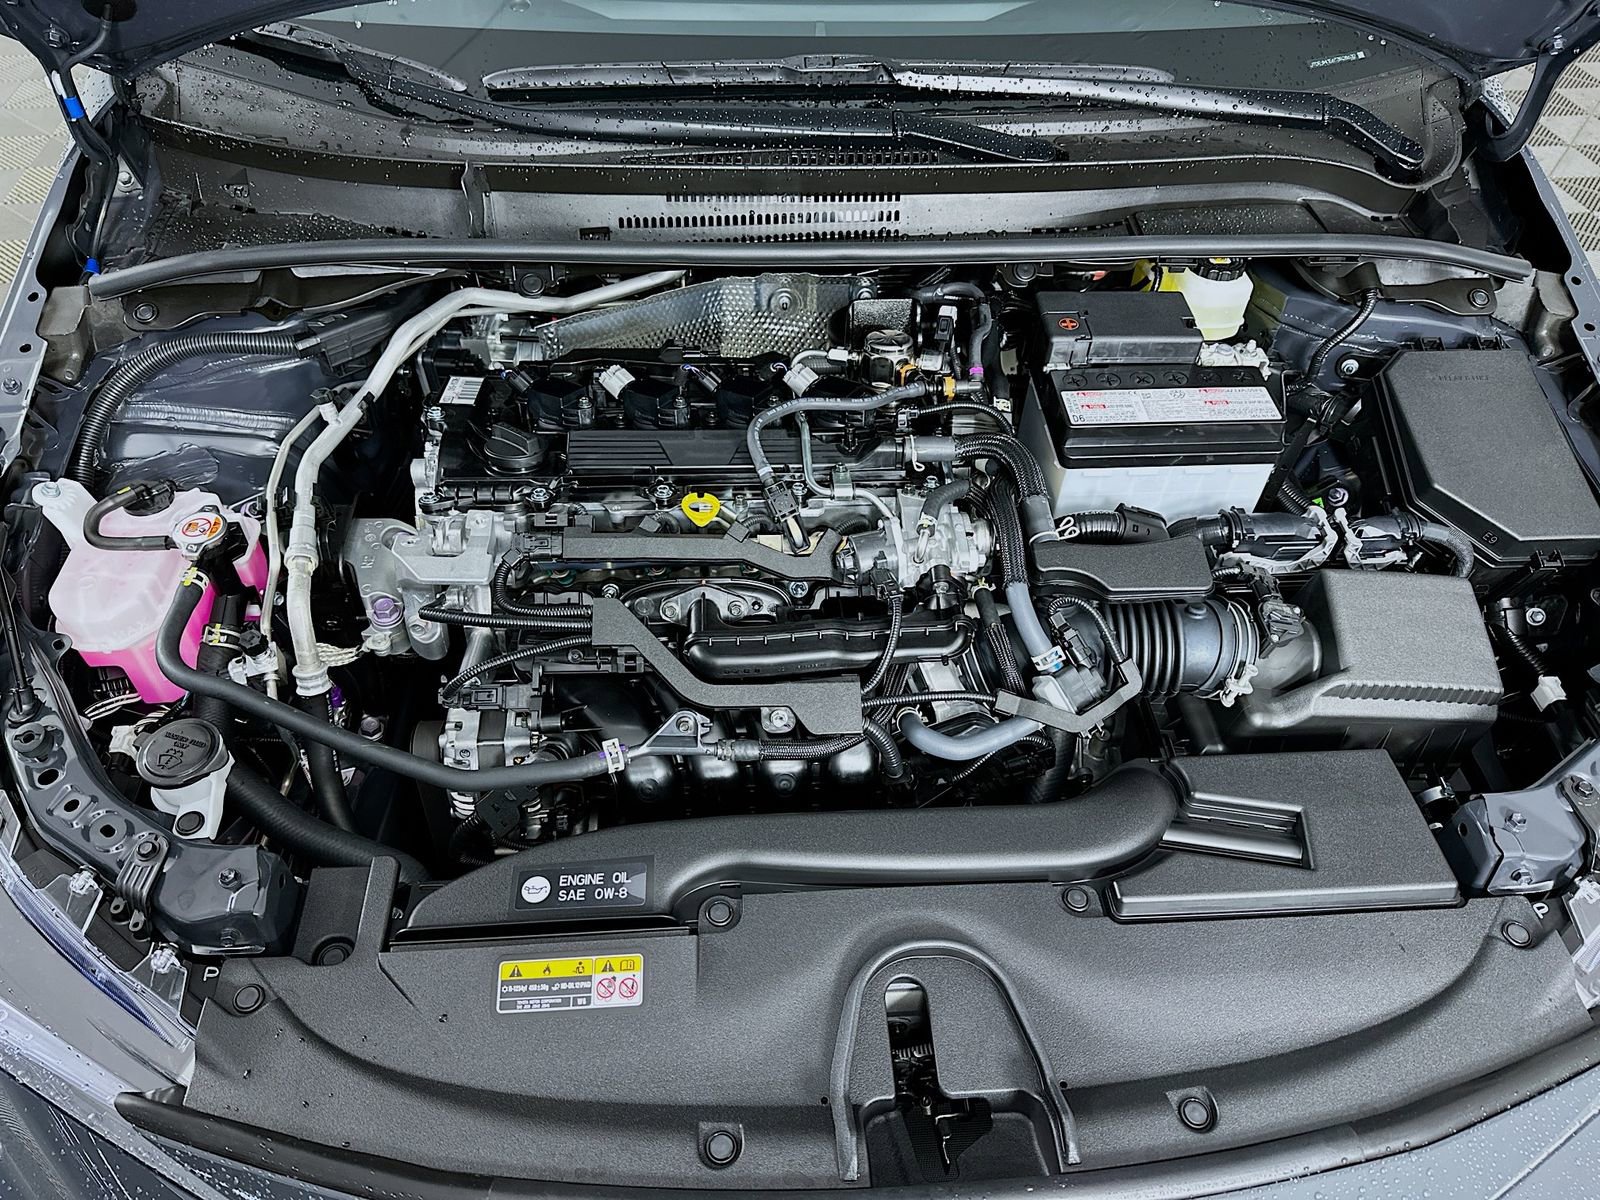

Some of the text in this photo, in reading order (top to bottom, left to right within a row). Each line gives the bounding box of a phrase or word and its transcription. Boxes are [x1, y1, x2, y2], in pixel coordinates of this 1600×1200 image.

[1072, 414, 1086, 422] D6
[1482, 531, 1498, 544] E9
[559, 871, 632, 887] ENGINE OIL
[558, 886, 628, 902] SAE 0W-8
[203, 966, 220, 982] P
